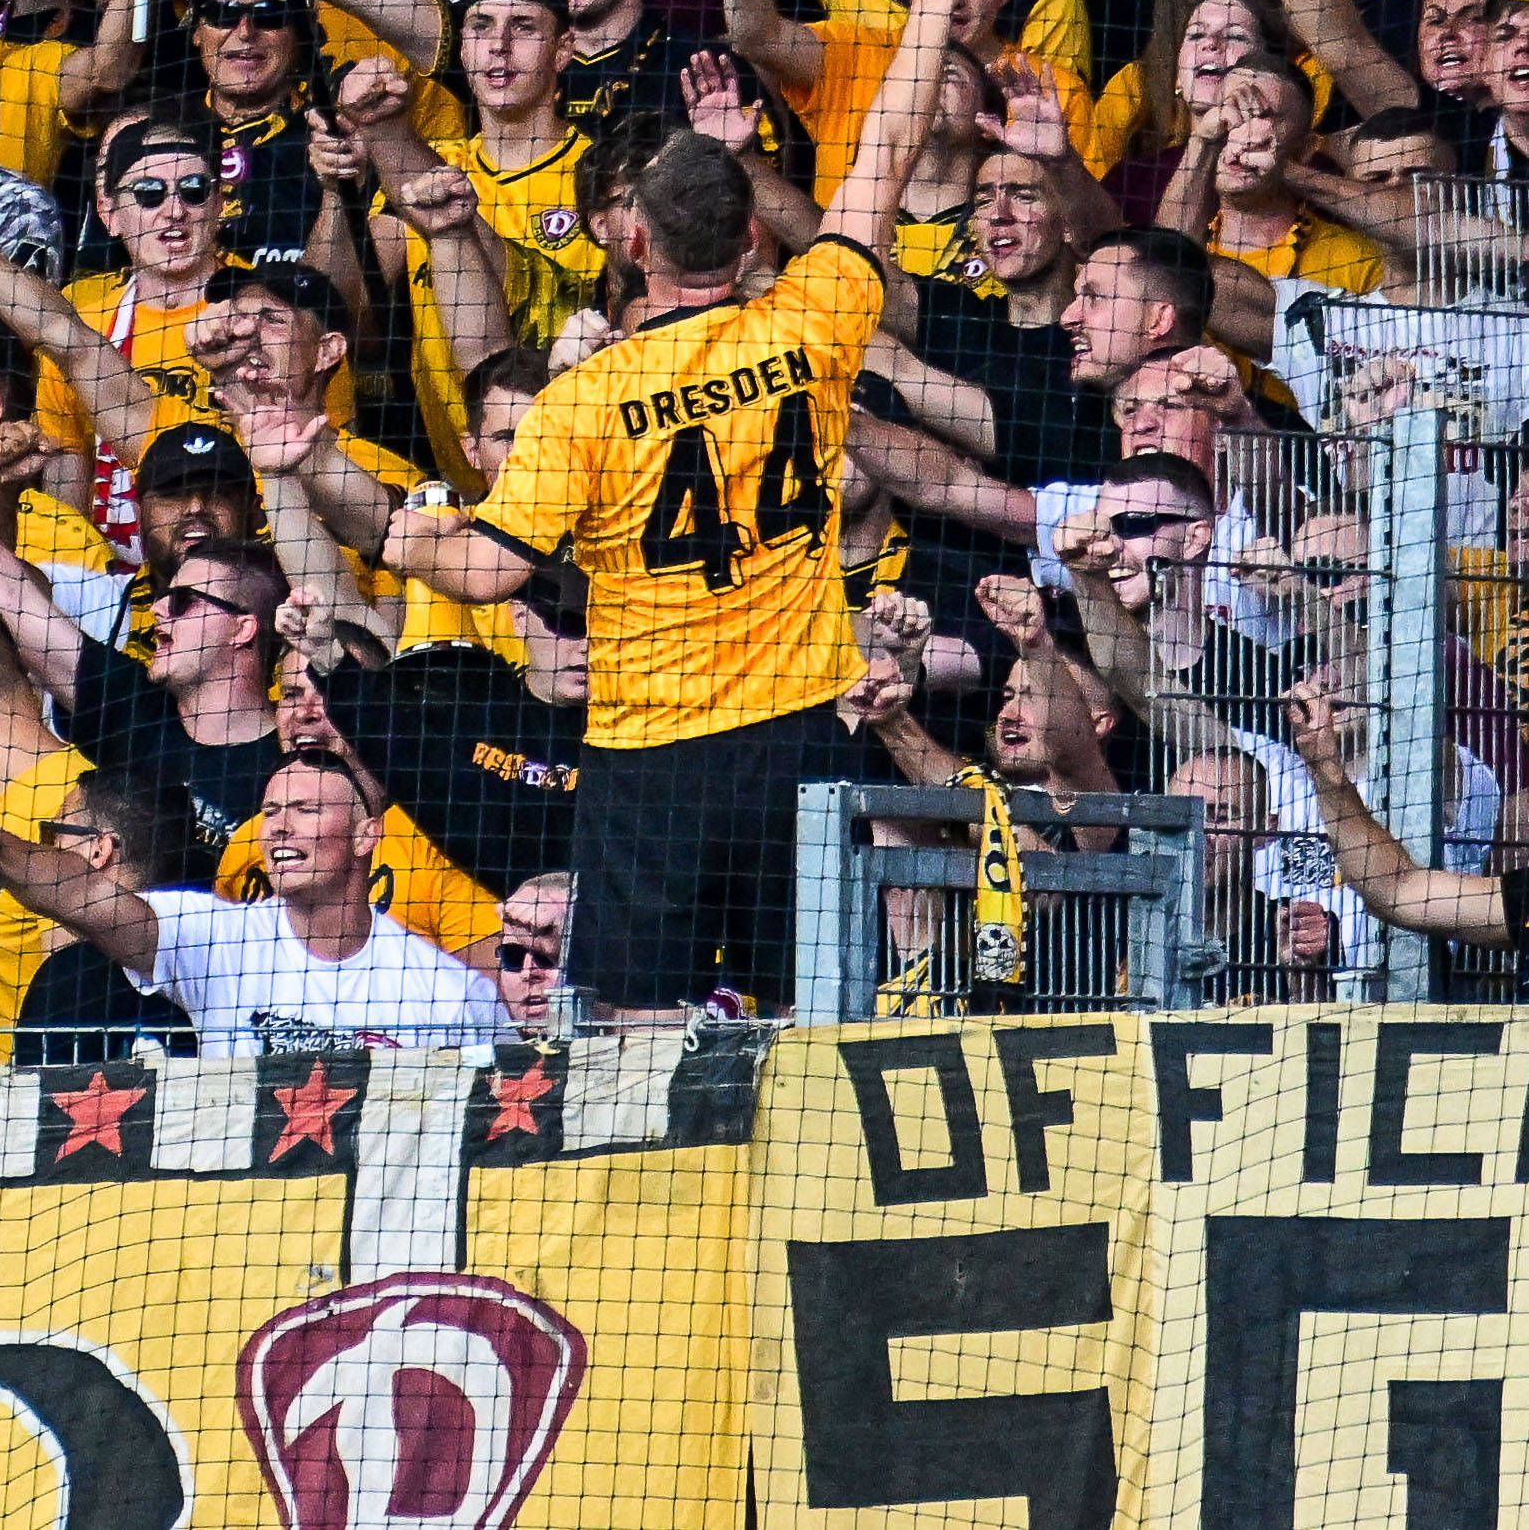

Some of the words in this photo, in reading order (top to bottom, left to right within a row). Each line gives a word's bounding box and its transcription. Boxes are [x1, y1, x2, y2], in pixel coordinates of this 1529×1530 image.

[621, 347, 815, 438] DRESDEN
[644, 391, 835, 595] 44
[837, 1021, 1529, 1207] OFFIC
